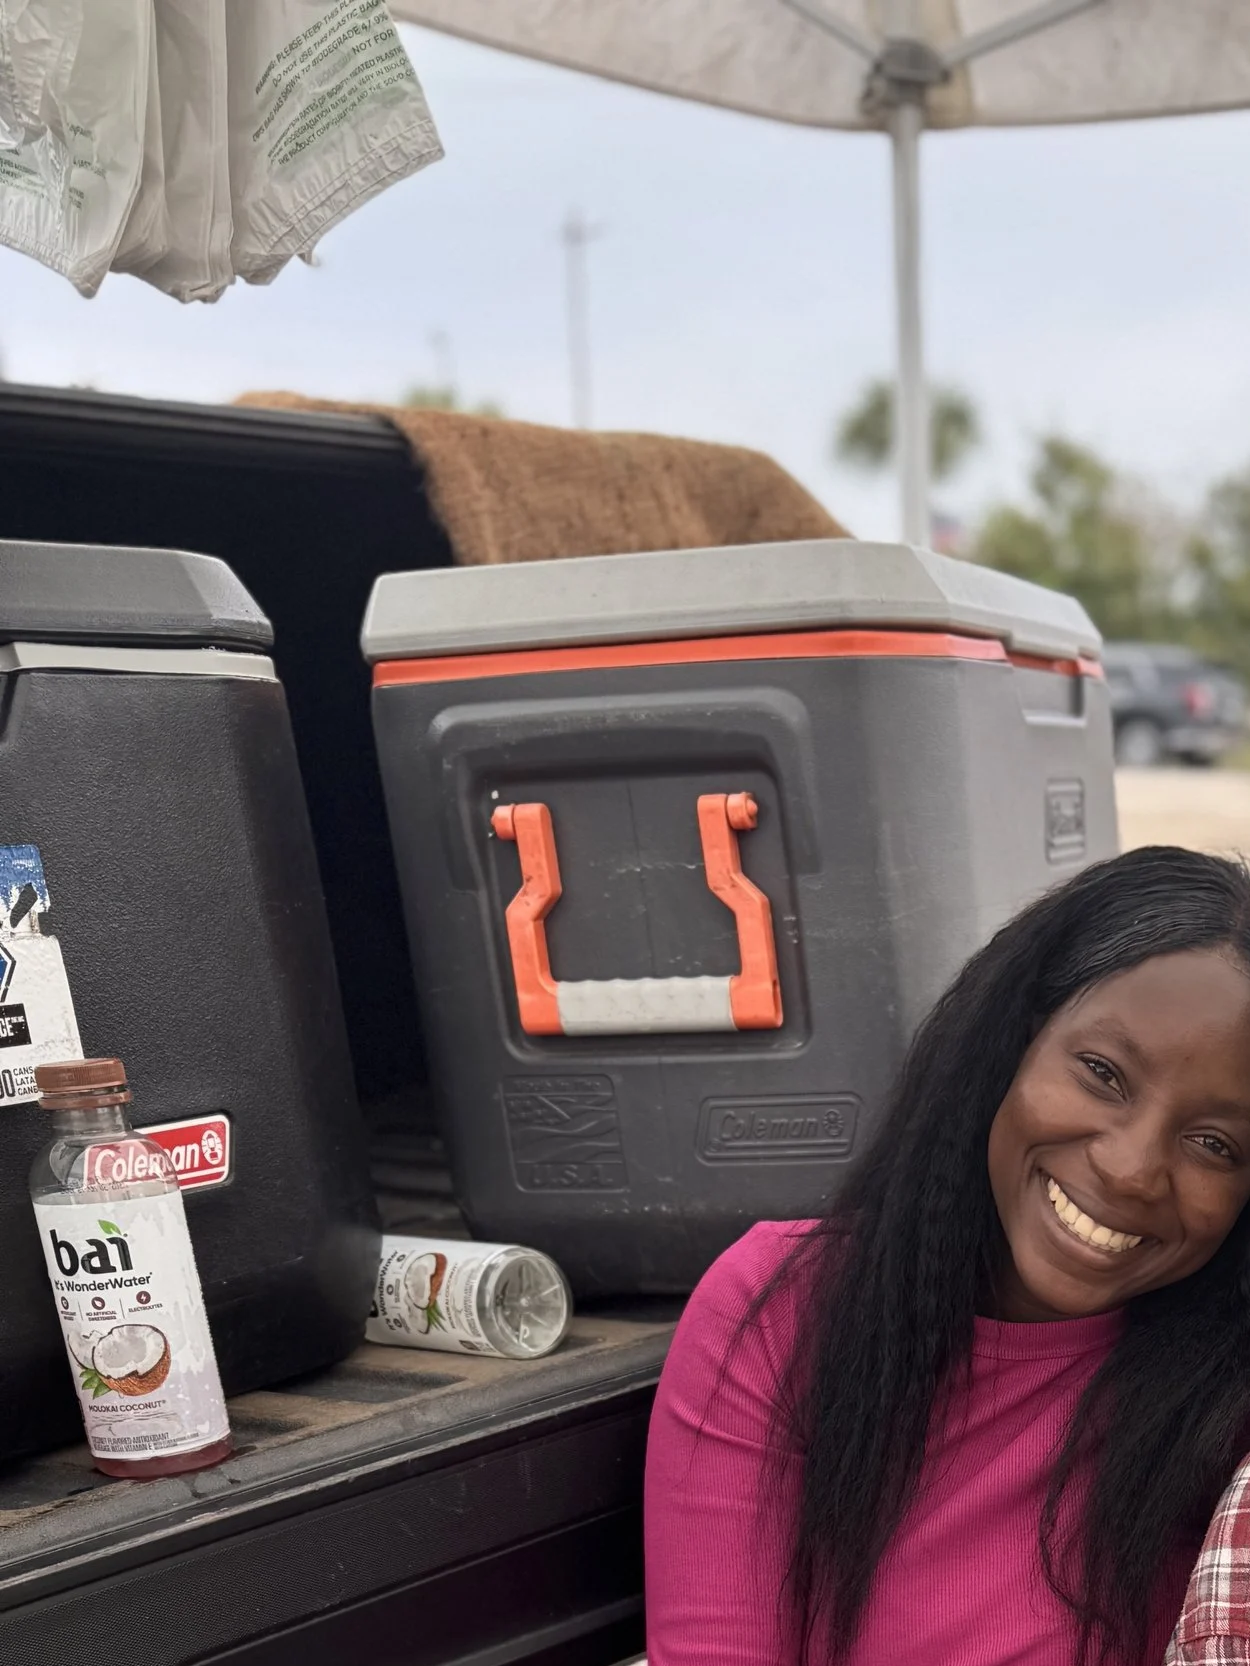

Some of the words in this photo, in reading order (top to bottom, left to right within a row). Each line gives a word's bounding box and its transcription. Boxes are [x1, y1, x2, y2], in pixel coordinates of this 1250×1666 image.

[323, 9, 339, 25] THIS
[351, 38, 372, 56] NOT
[373, 28, 395, 44] FOR
[13, 1066, 34, 1077] CANS
[15, 1076, 36, 1087] LATA
[719, 1110, 818, 1141] Coleman
[95, 1143, 199, 1183] Coleman
[50, 1220, 133, 1277] bai
[65, 1276, 151, 1293] WonderWater
[119, 1401, 163, 1413] COCONUT
